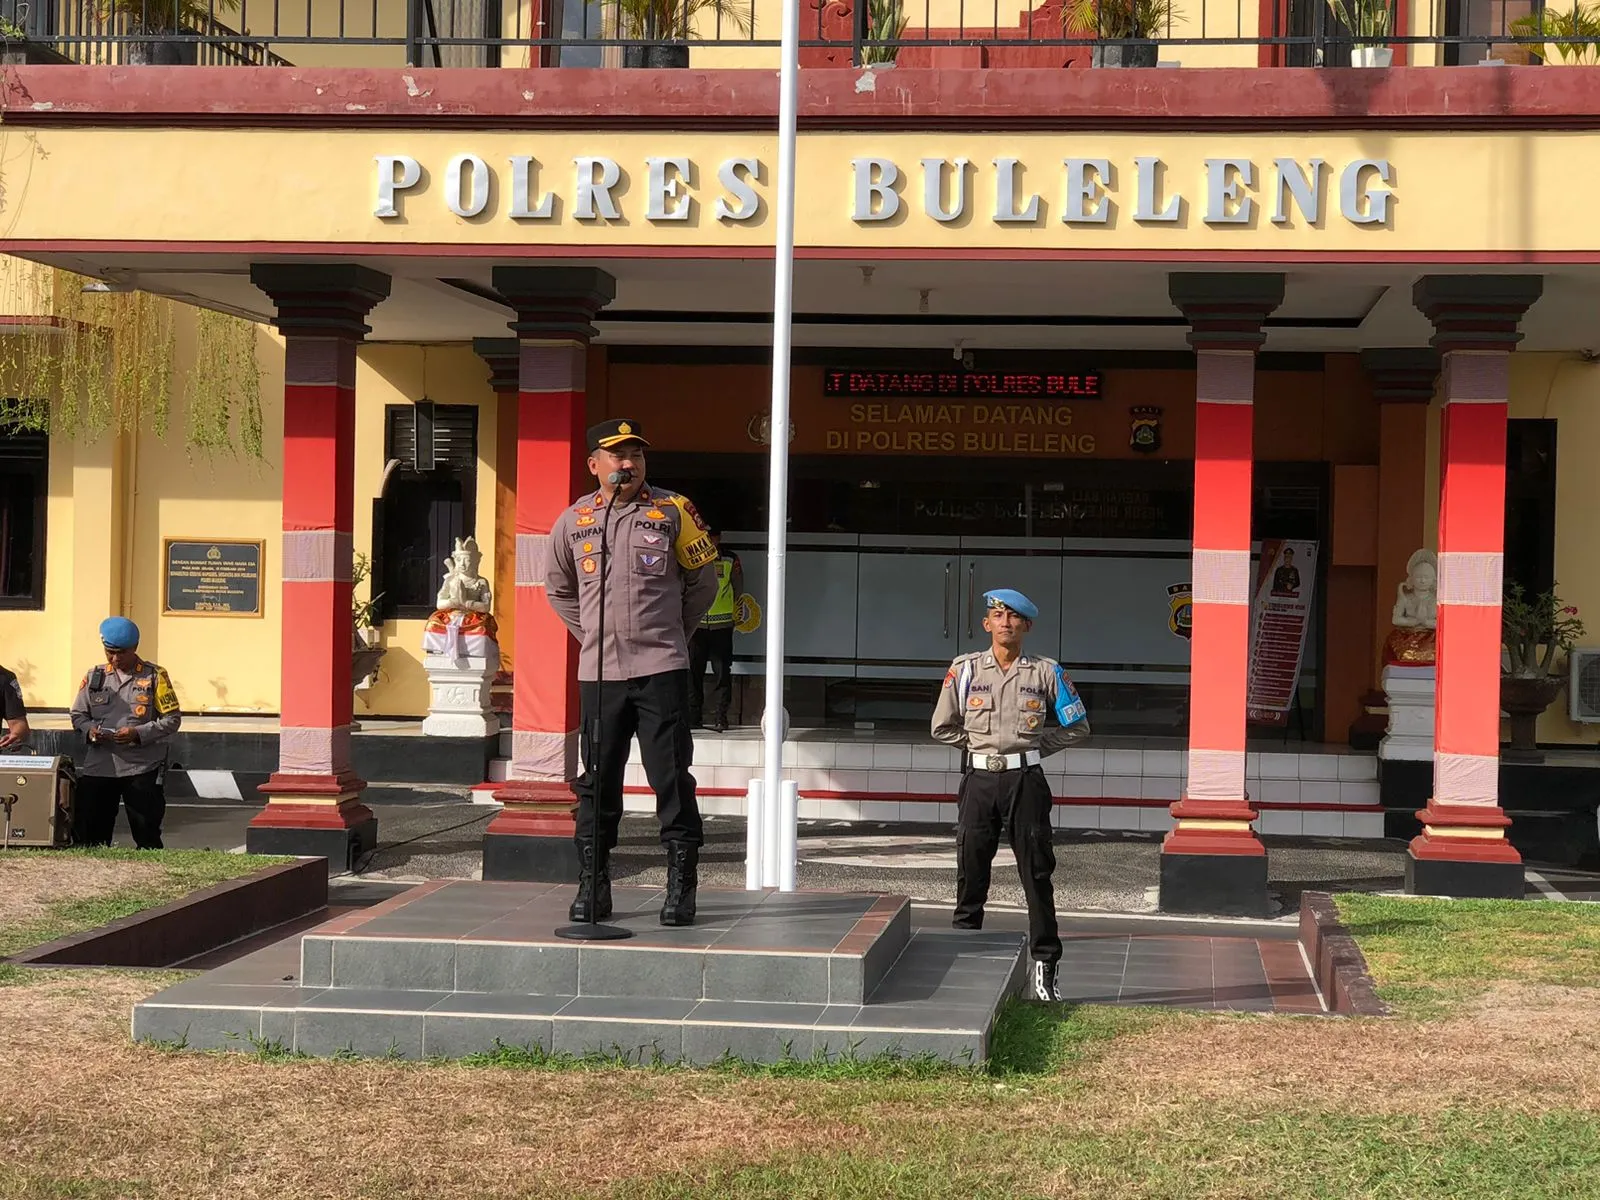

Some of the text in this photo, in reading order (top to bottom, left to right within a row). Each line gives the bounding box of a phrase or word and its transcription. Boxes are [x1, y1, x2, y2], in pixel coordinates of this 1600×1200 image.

[372, 155, 1394, 225] POLRES BULELENG
[963, 374, 1041, 393] POLRES
[849, 404, 1073, 426] SELAMAT DATANG
[826, 431, 1096, 453] DI POLRES BULELENG
[634, 520, 671, 533] POLRI
